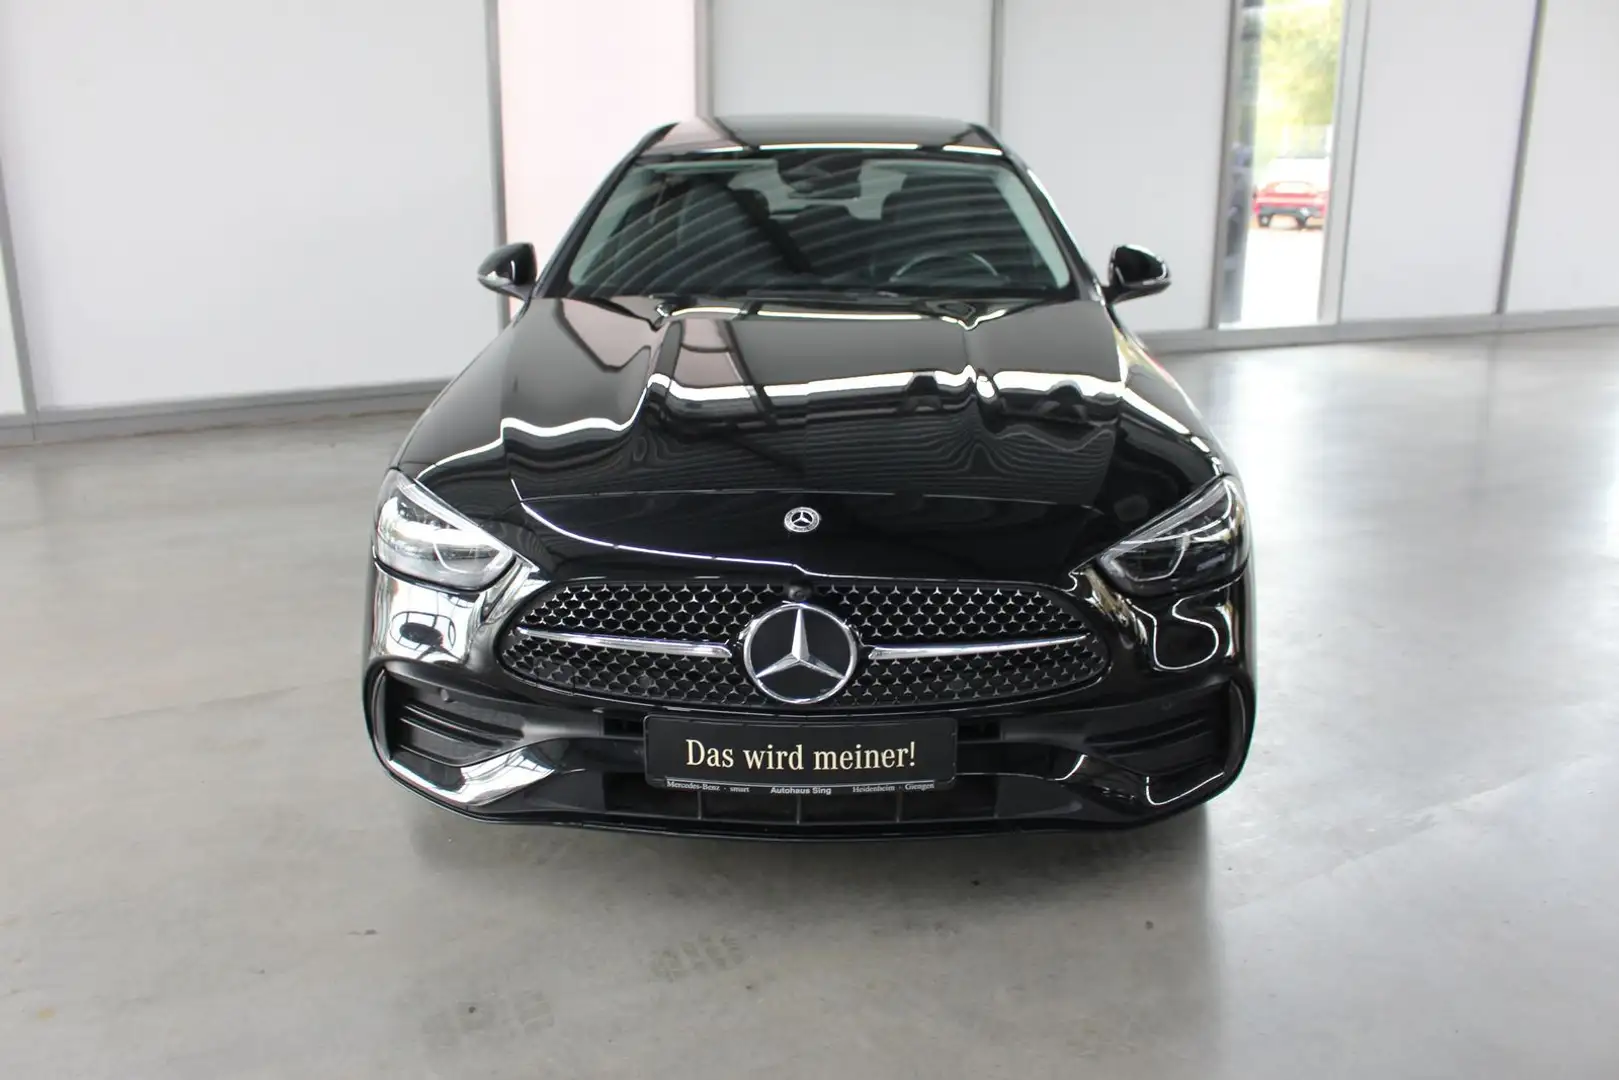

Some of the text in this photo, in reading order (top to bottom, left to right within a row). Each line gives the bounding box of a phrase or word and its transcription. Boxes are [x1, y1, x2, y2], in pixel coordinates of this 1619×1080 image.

[685, 739, 916, 770] Das wird meiner!
[666, 780, 720, 791] Mercedes-Benz
[770, 786, 832, 795] Autohaus Sing
[852, 785, 896, 793] Heidenheim
